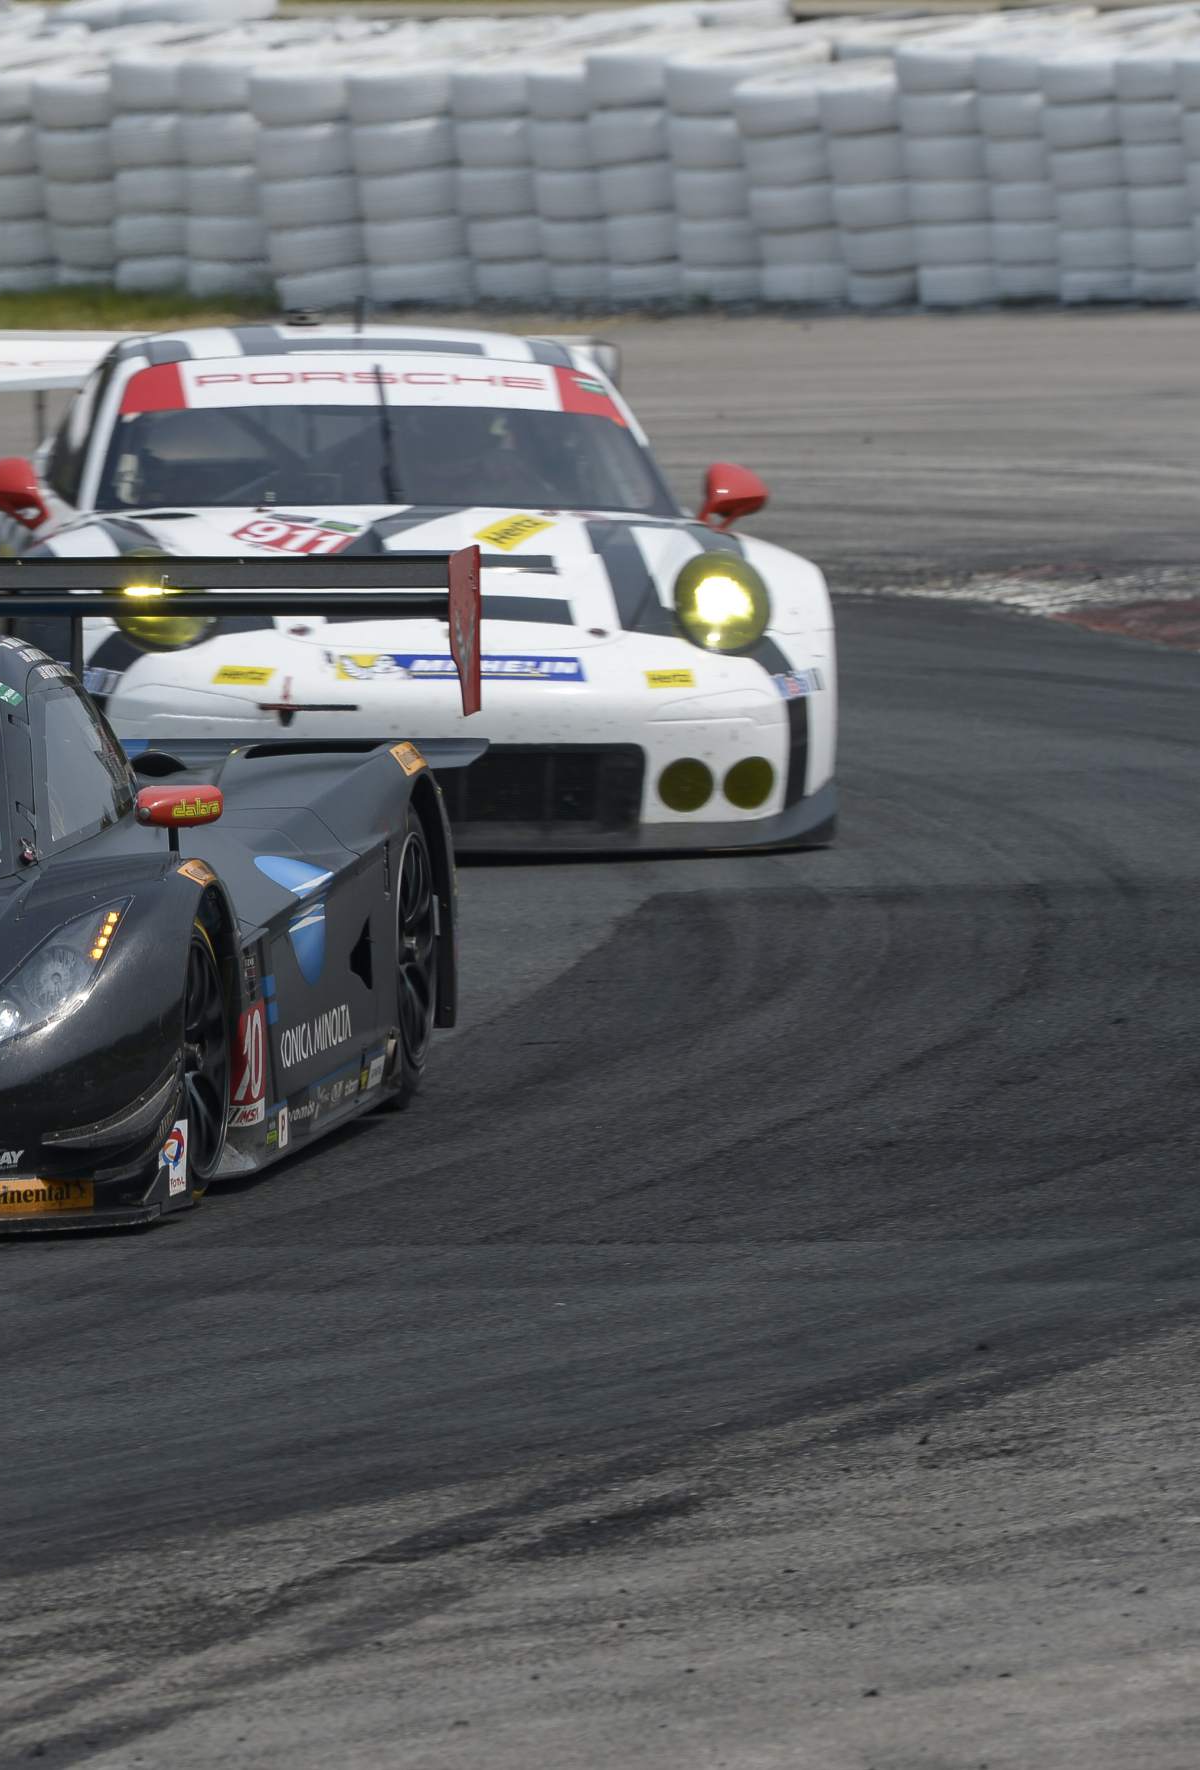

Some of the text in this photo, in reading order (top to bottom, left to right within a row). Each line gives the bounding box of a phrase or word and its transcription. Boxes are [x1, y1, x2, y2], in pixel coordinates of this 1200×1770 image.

[194, 371, 546, 390] PORSCHE
[240, 520, 345, 553] 911
[484, 516, 541, 546] Hertz
[410, 658, 579, 674] MIHELIN
[172, 797, 220, 818] dallara
[314, 1004, 352, 1051] MINOLTA
[234, 1009, 263, 1101] 10
